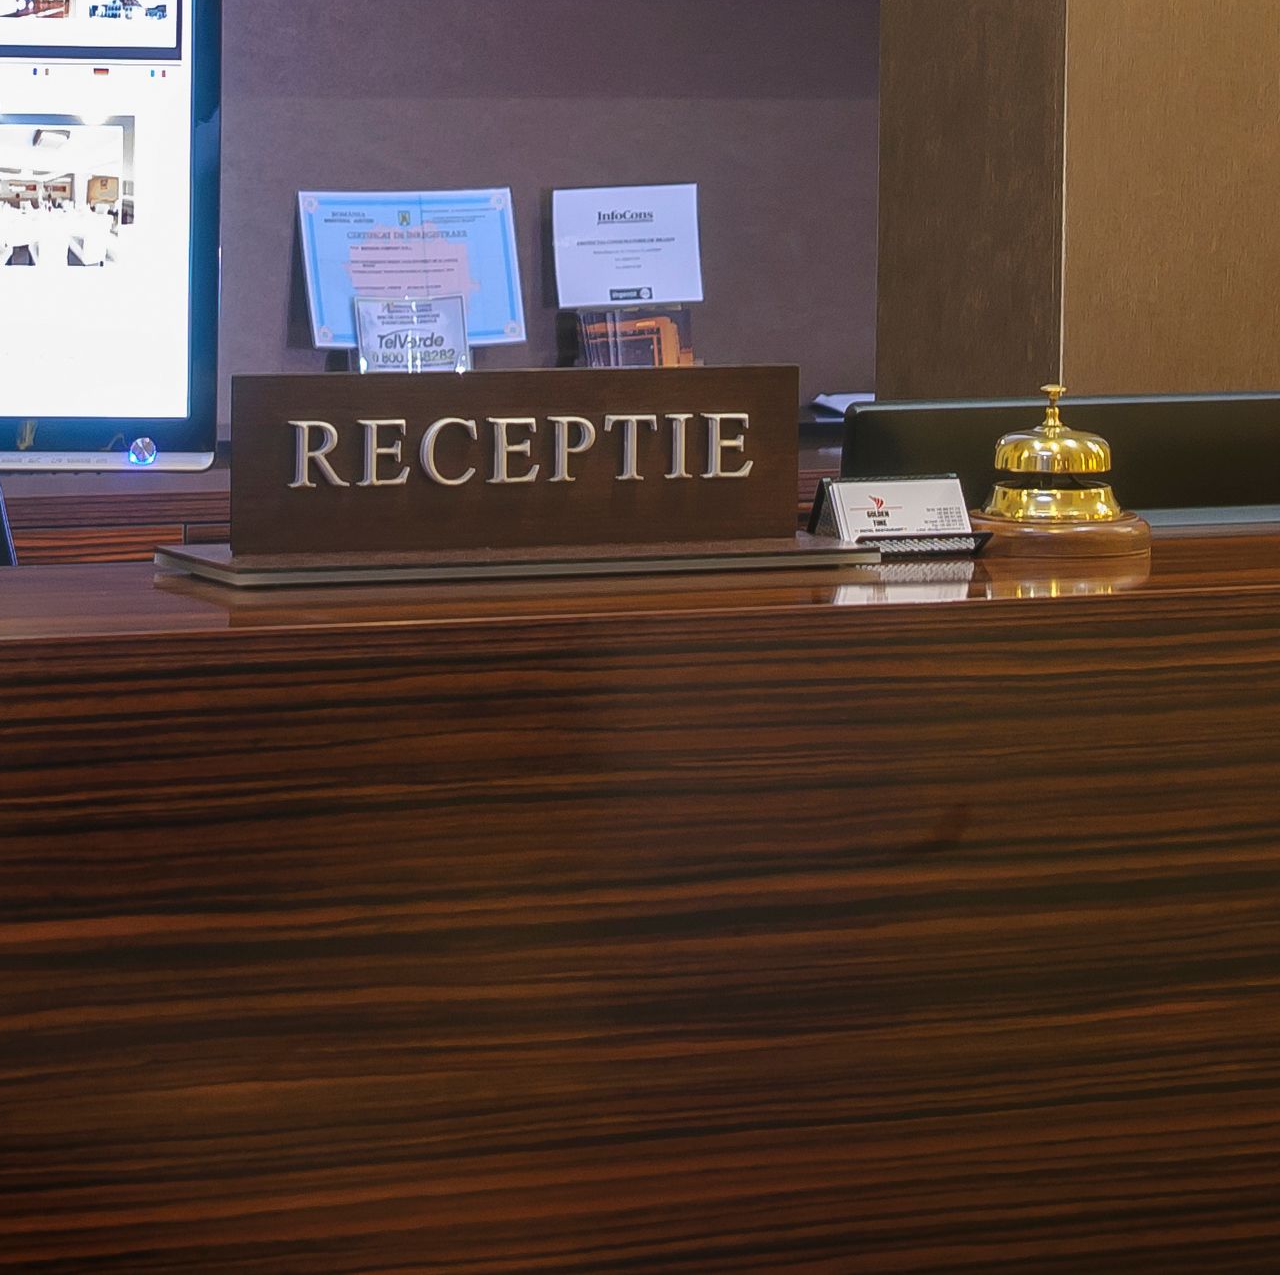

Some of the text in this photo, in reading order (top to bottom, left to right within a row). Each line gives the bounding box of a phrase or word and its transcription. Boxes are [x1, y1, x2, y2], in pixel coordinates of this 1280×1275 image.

[597, 209, 654, 222] InfoCons
[377, 331, 445, 350] TelVerde
[287, 412, 755, 488] RECEPTIE
[866, 510, 890, 518] GOLDEN
